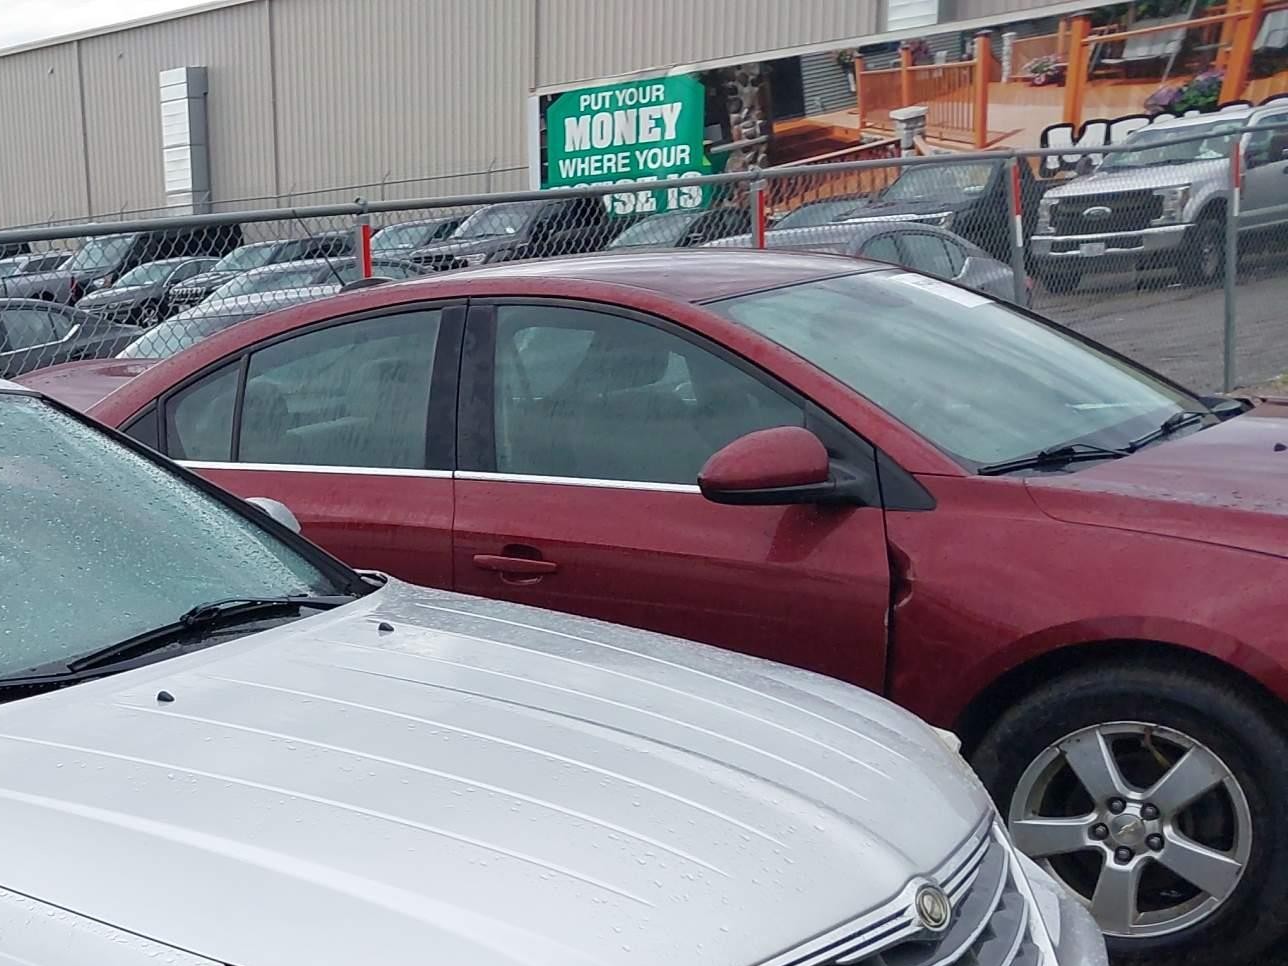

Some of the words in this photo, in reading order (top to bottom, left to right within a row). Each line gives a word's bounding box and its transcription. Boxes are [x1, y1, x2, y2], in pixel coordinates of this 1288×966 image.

[580, 91, 613, 112] PUT
[615, 84, 665, 106] YOUR
[564, 102, 682, 152] MONEY
[559, 152, 631, 178] WHERE
[635, 144, 691, 170] YOUR
